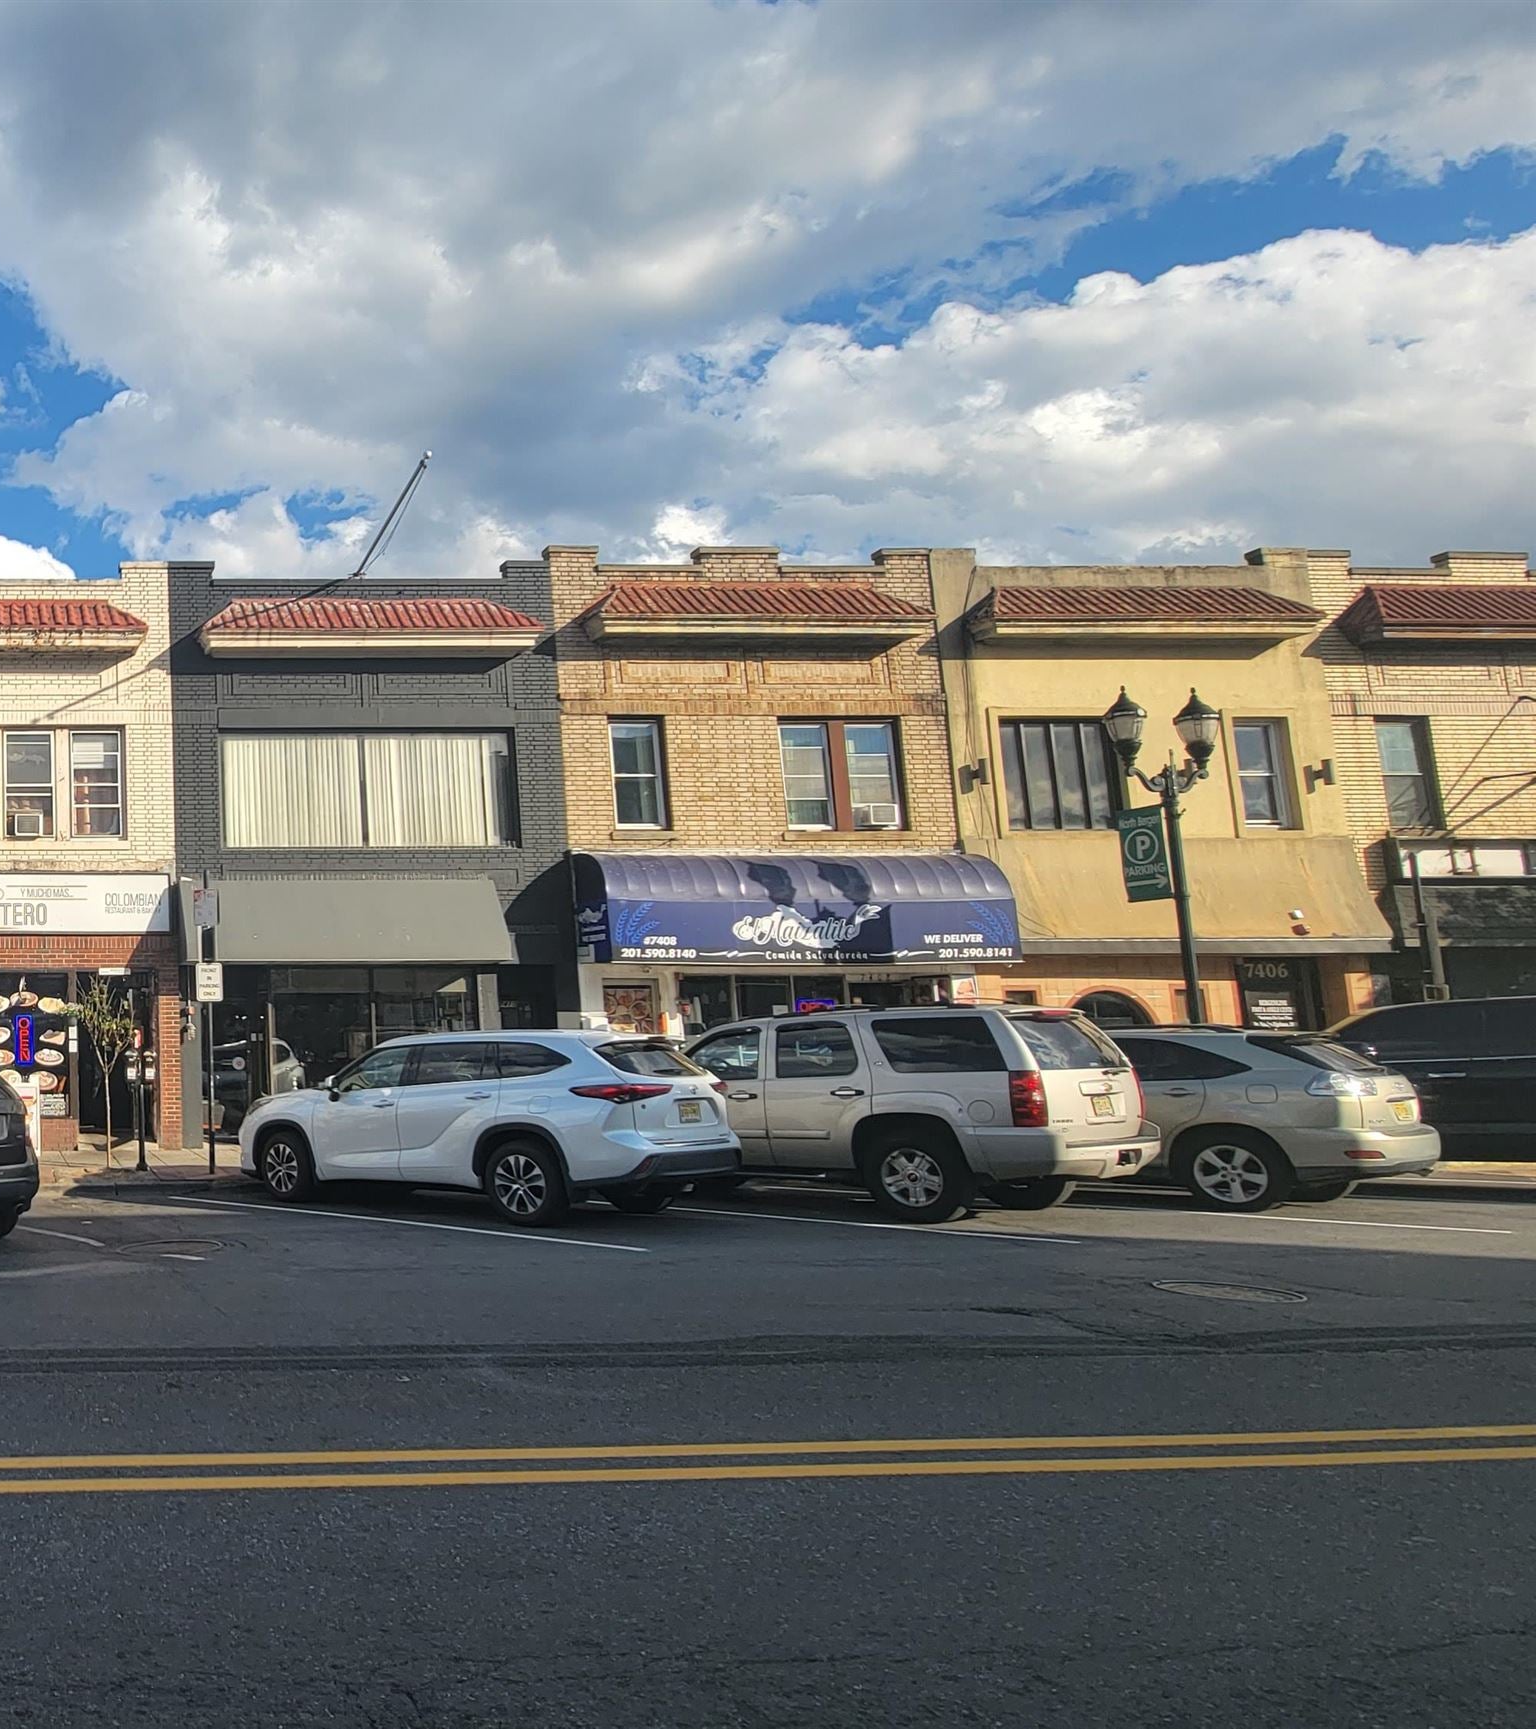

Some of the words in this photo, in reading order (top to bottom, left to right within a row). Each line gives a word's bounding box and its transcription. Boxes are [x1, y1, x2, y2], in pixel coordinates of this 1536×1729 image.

[1135, 835, 1151, 860] P
[1124, 862, 1166, 877] PARKING
[26, 887, 51, 898] MUCHO
[105, 892, 161, 906] COLOMBIAN
[644, 936, 677, 946] #7408
[924, 934, 941, 944] WE
[943, 934, 983, 944] DELIVER
[621, 947, 696, 959] 201.590.8140
[765, 950, 802, 960] Comida
[938, 947, 1013, 958] 201.590.8141
[1244, 963, 1289, 978] 7406
[18, 1017, 31, 1062] OPEN
